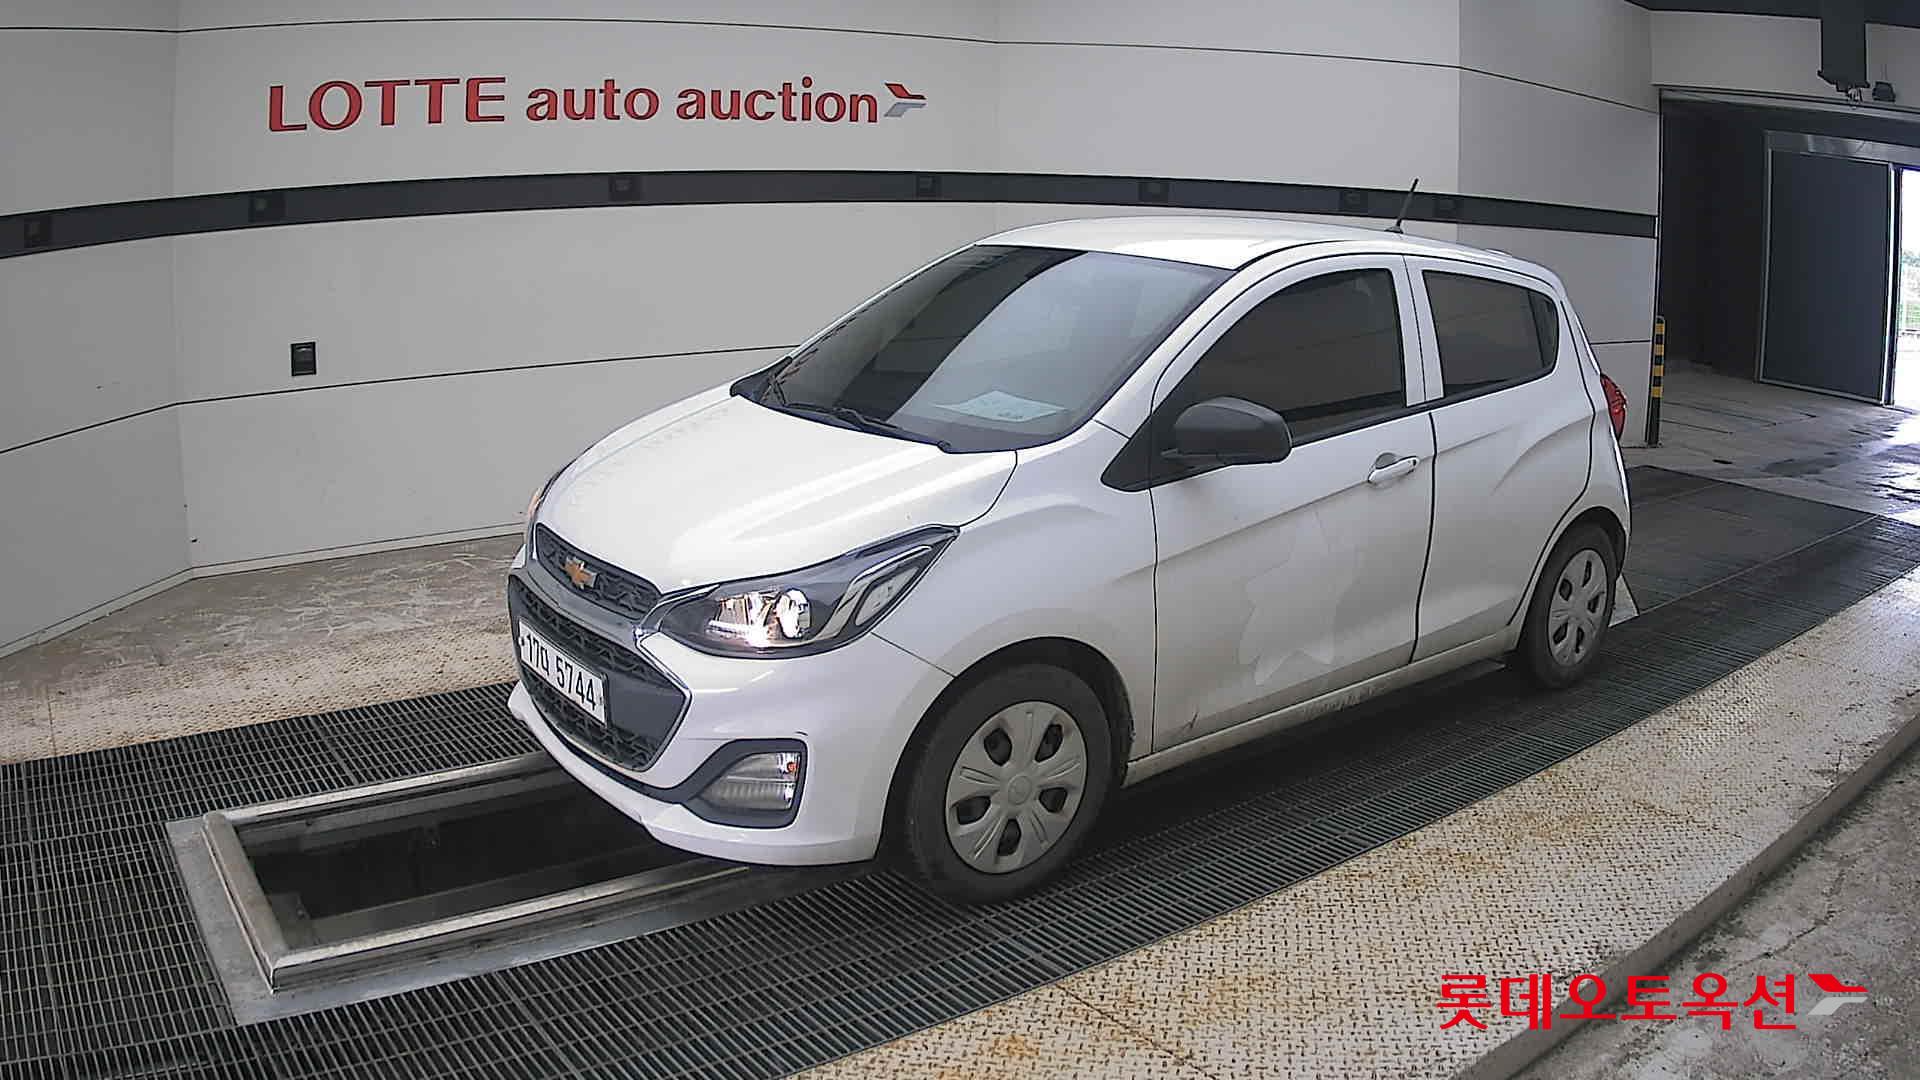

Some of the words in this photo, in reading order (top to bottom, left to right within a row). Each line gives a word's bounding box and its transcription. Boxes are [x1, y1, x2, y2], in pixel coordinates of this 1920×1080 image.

[269, 77, 506, 132] LOTTE
[526, 78, 660, 121] auto
[676, 77, 878, 123] auction
[556, 655, 596, 711] 5744
